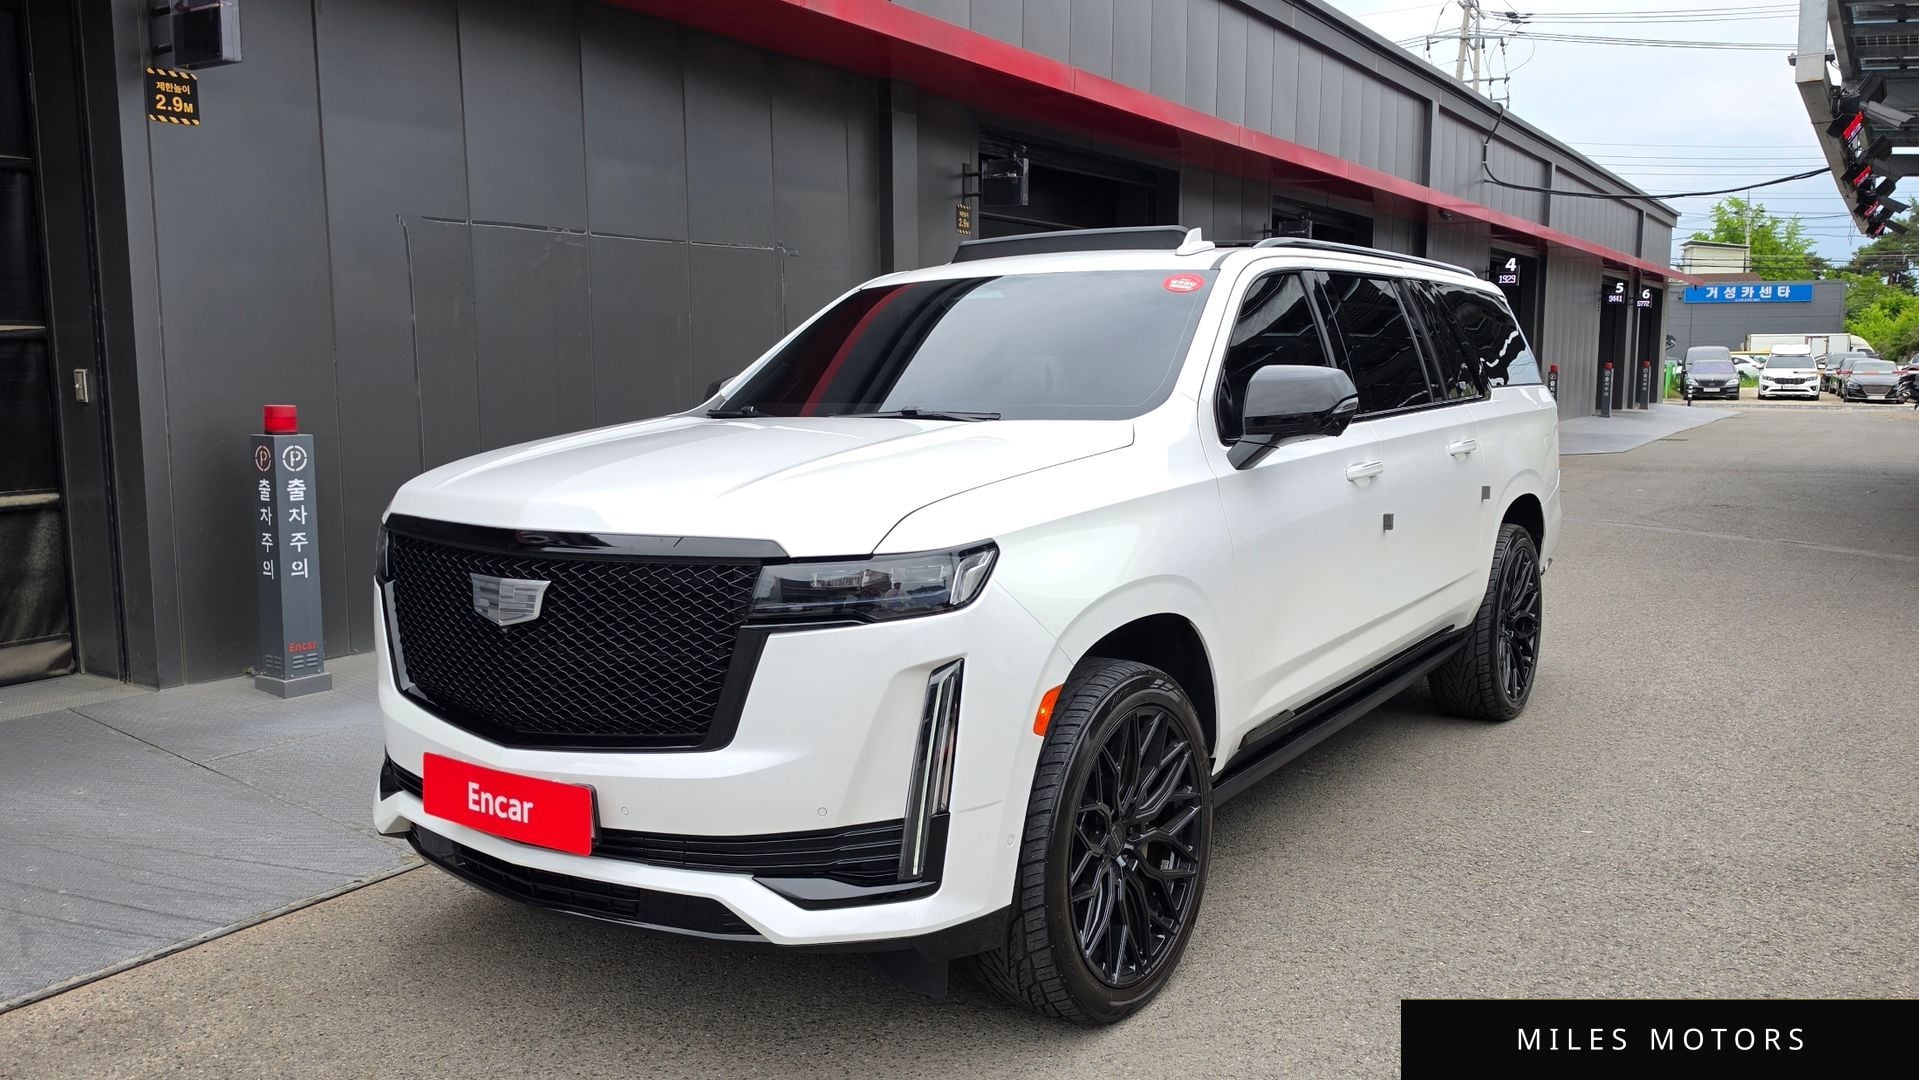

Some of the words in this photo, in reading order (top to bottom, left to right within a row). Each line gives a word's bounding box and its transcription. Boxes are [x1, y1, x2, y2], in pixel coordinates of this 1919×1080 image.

[155, 82, 190, 95] 제한높이
[155, 94, 193, 113] 2.9M
[1505, 257, 1517, 272] 4
[1498, 274, 1517, 284] 1929
[1615, 282, 1624, 293] 5
[1642, 288, 1650, 299] 6
[1706, 286, 1791, 299] 거성카센타
[289, 641, 317, 653] Encar
[467, 781, 534, 824] Encar
